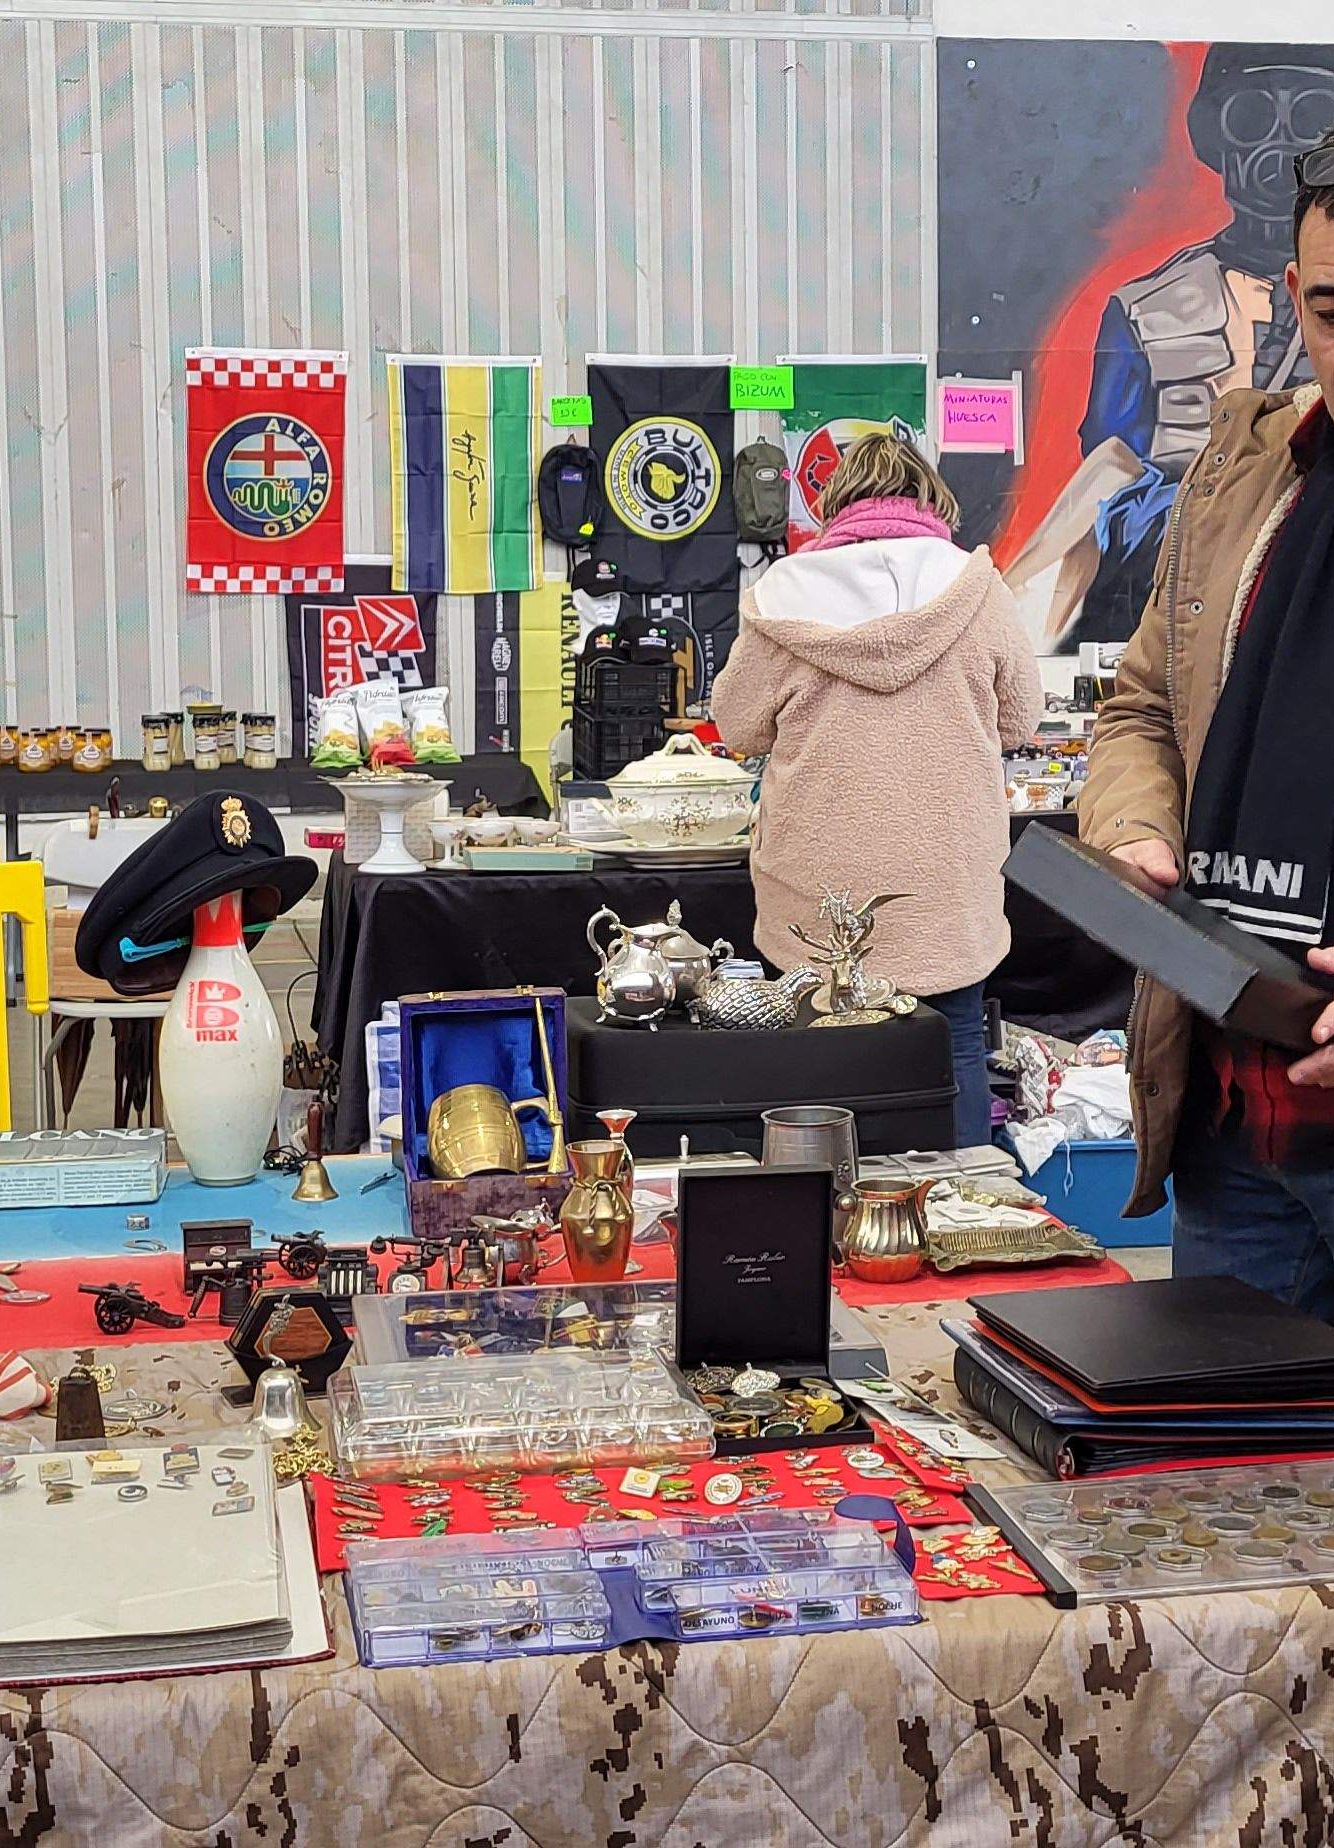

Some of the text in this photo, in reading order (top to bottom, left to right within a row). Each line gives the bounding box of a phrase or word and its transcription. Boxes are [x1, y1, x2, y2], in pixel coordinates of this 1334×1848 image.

[735, 383, 785, 398] BIZUM
[944, 393, 1007, 405] MINIATURAS
[947, 410, 996, 424] HUESCA
[263, 418, 327, 537] ALFA ROMEO
[704, 633, 714, 658] ISLE
[196, 1030, 238, 1042] max
